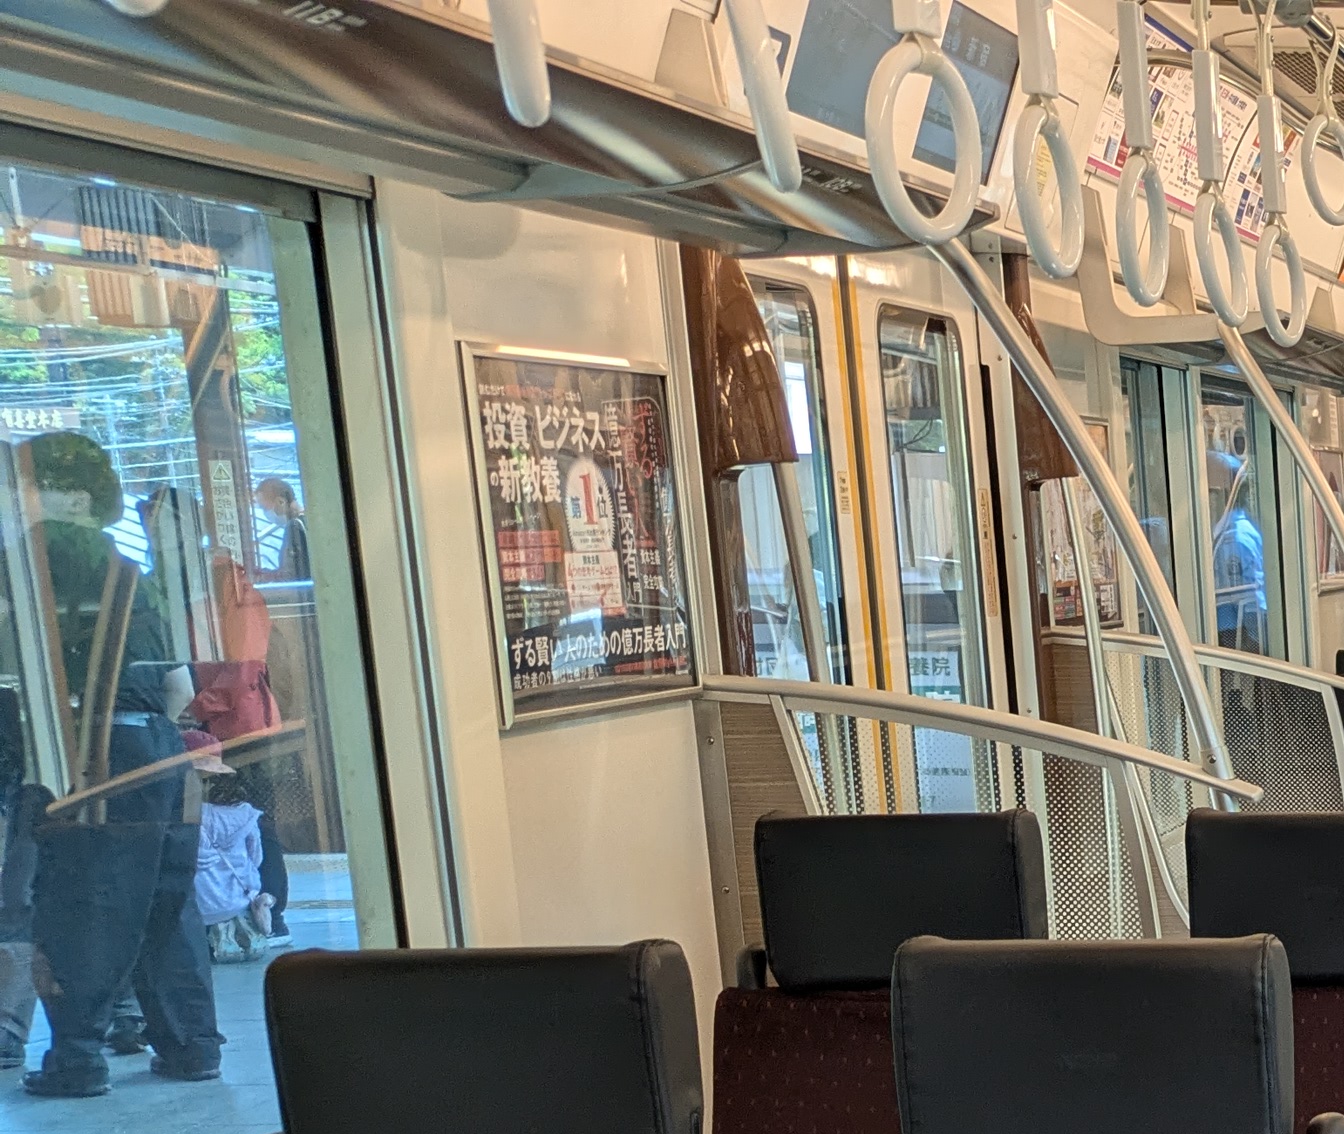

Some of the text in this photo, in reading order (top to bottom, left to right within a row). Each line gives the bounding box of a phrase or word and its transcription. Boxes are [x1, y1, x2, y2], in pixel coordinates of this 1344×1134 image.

[483, 401, 606, 453] 投資 ビジネス
[490, 455, 561, 503] の新教養
[511, 622, 687, 670] ずる賢い人のための億万長者入門
